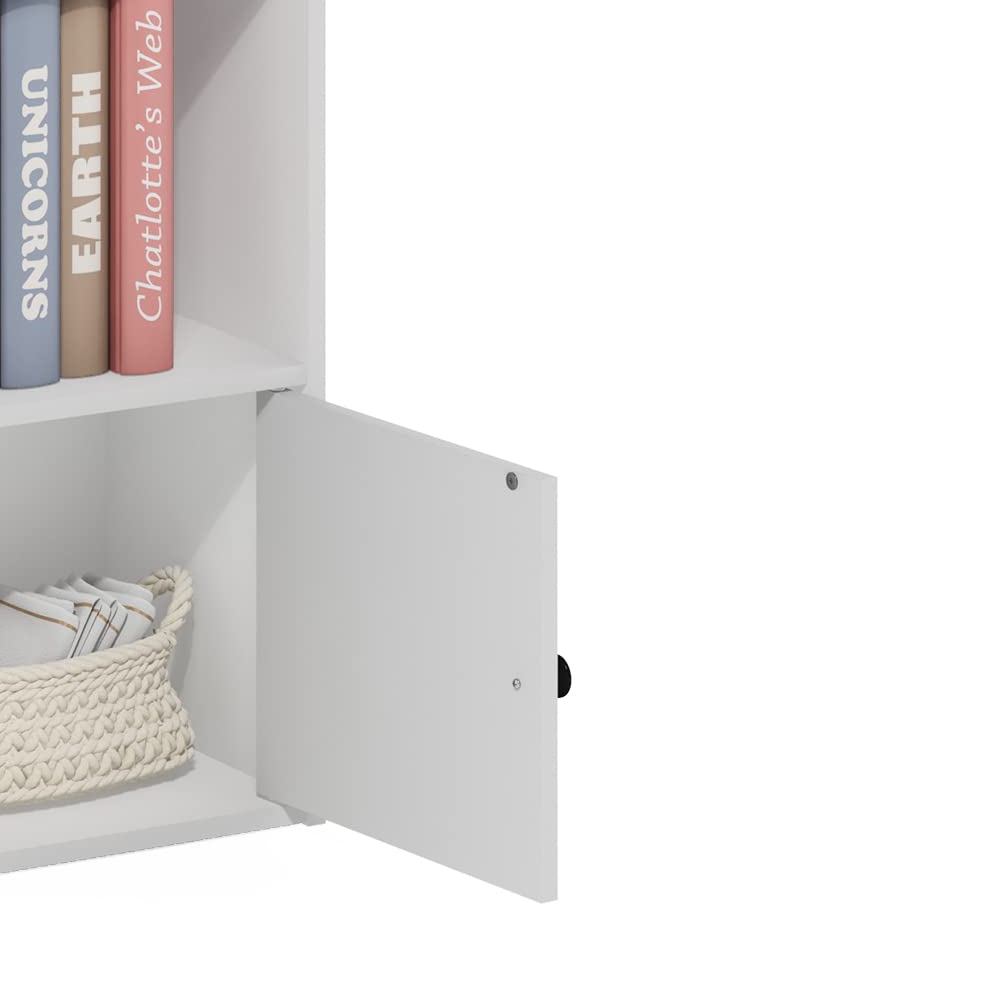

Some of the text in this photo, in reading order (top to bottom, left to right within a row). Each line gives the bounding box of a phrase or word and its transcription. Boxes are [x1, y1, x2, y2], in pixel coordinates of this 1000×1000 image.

[135, 9, 162, 95] Web
[21, 64, 49, 321] UNICORNS
[71, 71, 102, 275] EARTH
